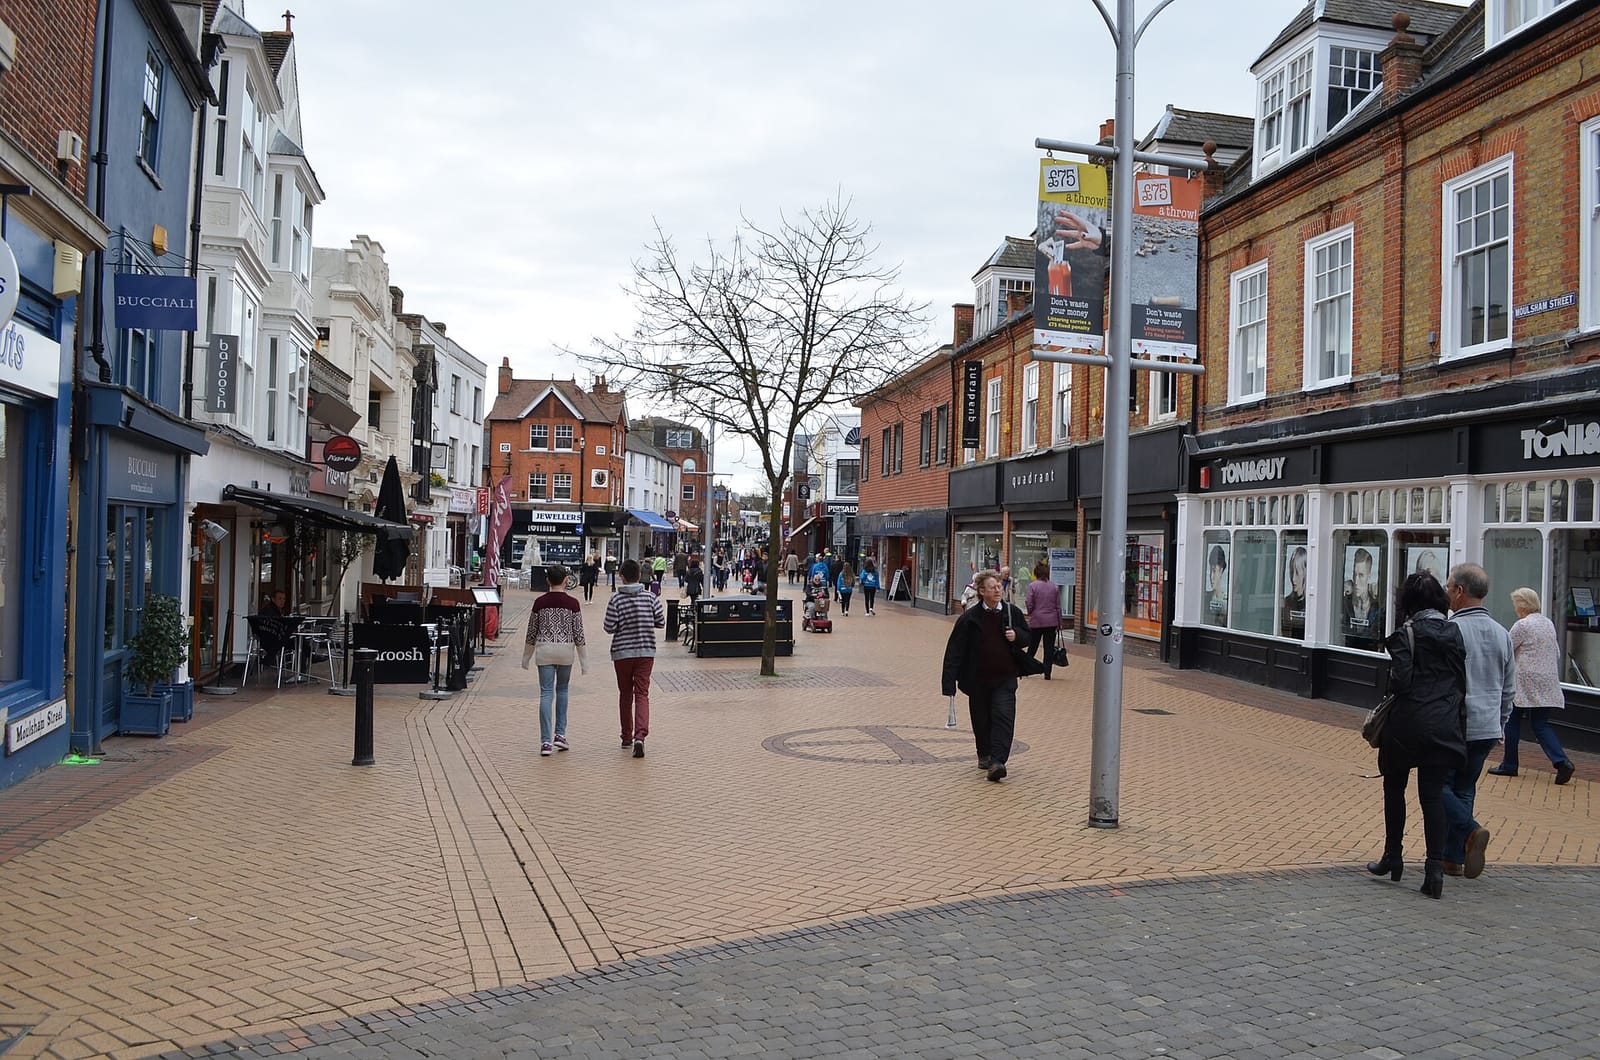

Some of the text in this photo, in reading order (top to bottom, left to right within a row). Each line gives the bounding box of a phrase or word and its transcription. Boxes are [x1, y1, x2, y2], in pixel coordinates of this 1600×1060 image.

[1047, 169, 1076, 188] £75
[1065, 192, 1107, 207] a throw!
[1142, 183, 1168, 201] £75
[1159, 205, 1197, 220] a throw!
[117, 296, 195, 309] BUCCIALI
[1050, 297, 1089, 309] Don't waste
[1515, 295, 1573, 317] MOULSHAM STREET
[1050, 307, 1089, 319] your money
[1145, 307, 1182, 319] Don't waste
[1145, 317, 1183, 329] your money
[217, 339, 229, 409] baroosh
[968, 367, 977, 423] quadrant
[128, 456, 157, 479] BUCCIALI
[1221, 457, 1286, 484] TONI&GUY
[1012, 469, 1055, 488] quadrant
[536, 512, 582, 521] JEWELLERS
[376, 647, 424, 661] roosh
[16, 706, 63, 742] Moulsham Street
